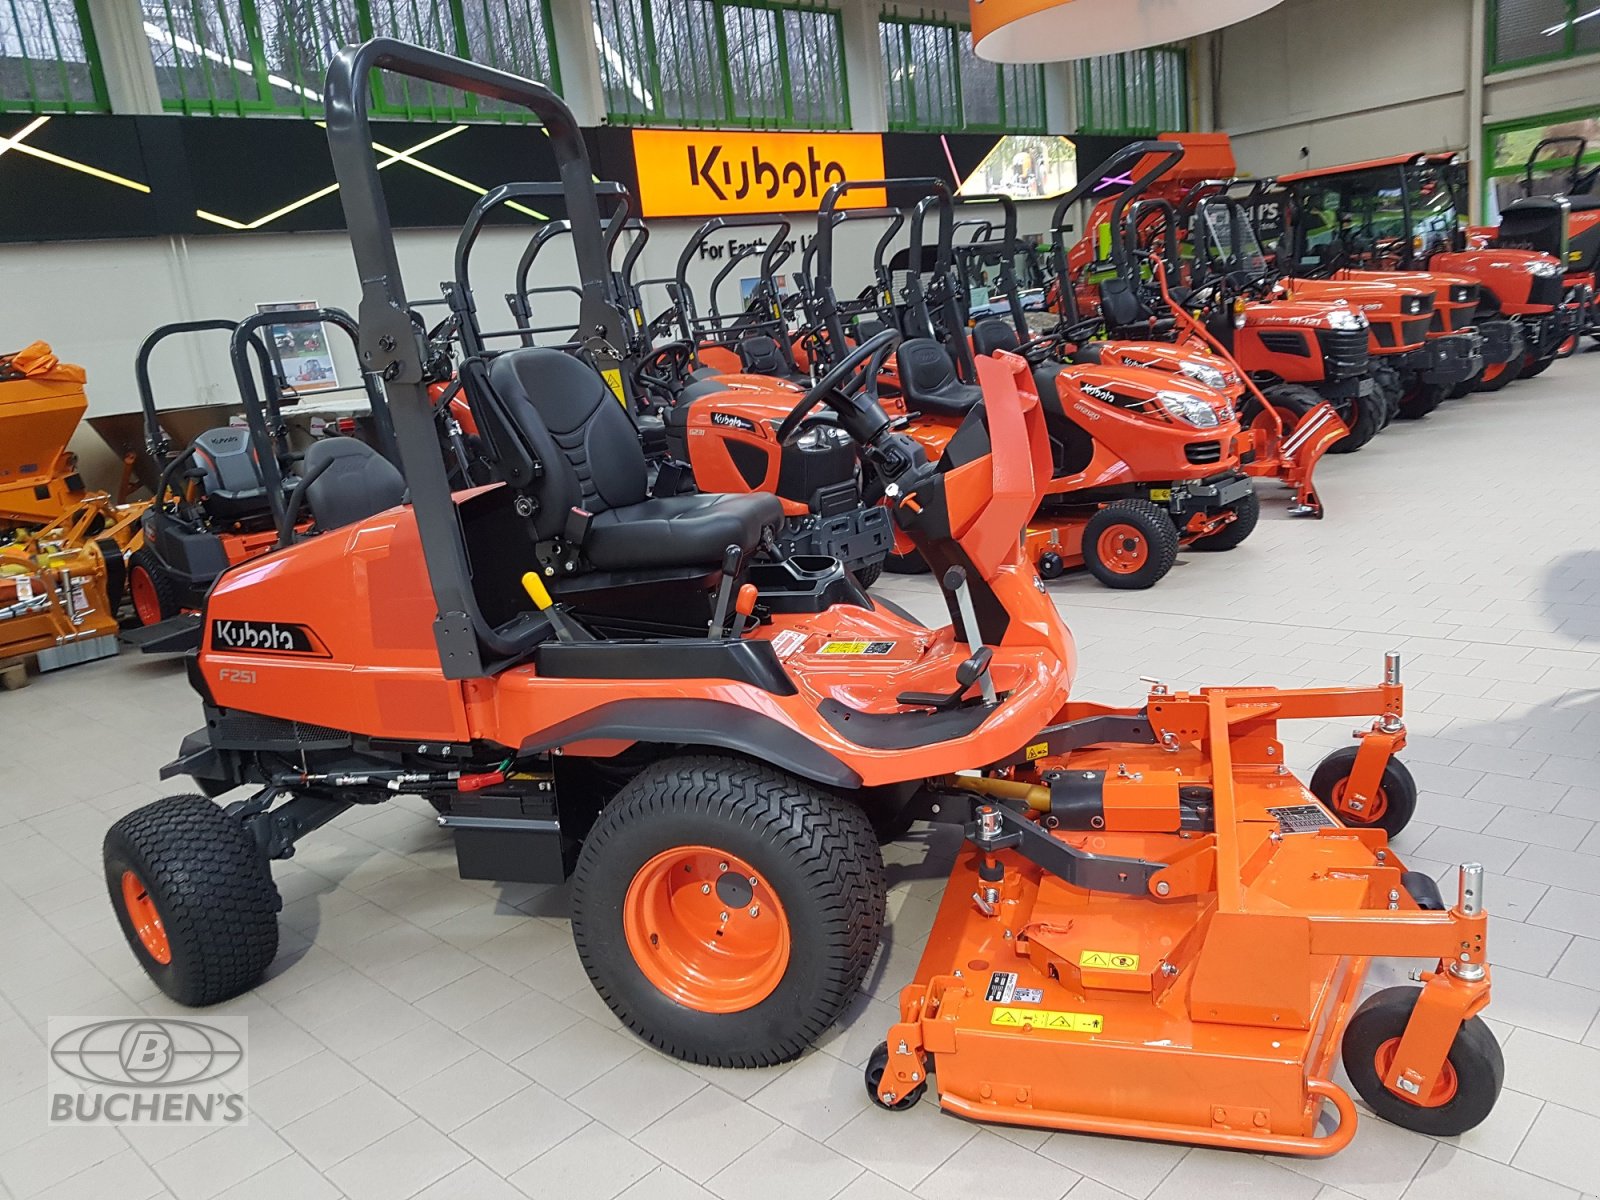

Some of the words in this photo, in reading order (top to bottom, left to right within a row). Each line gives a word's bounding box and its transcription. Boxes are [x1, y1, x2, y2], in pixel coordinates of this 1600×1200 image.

[687, 145, 848, 200] Kubota
[700, 240, 724, 259] For
[1083, 383, 1115, 403] Kubota
[714, 413, 741, 427] Kubota
[217, 620, 294, 650] Kubota
[220, 668, 257, 684] F251
